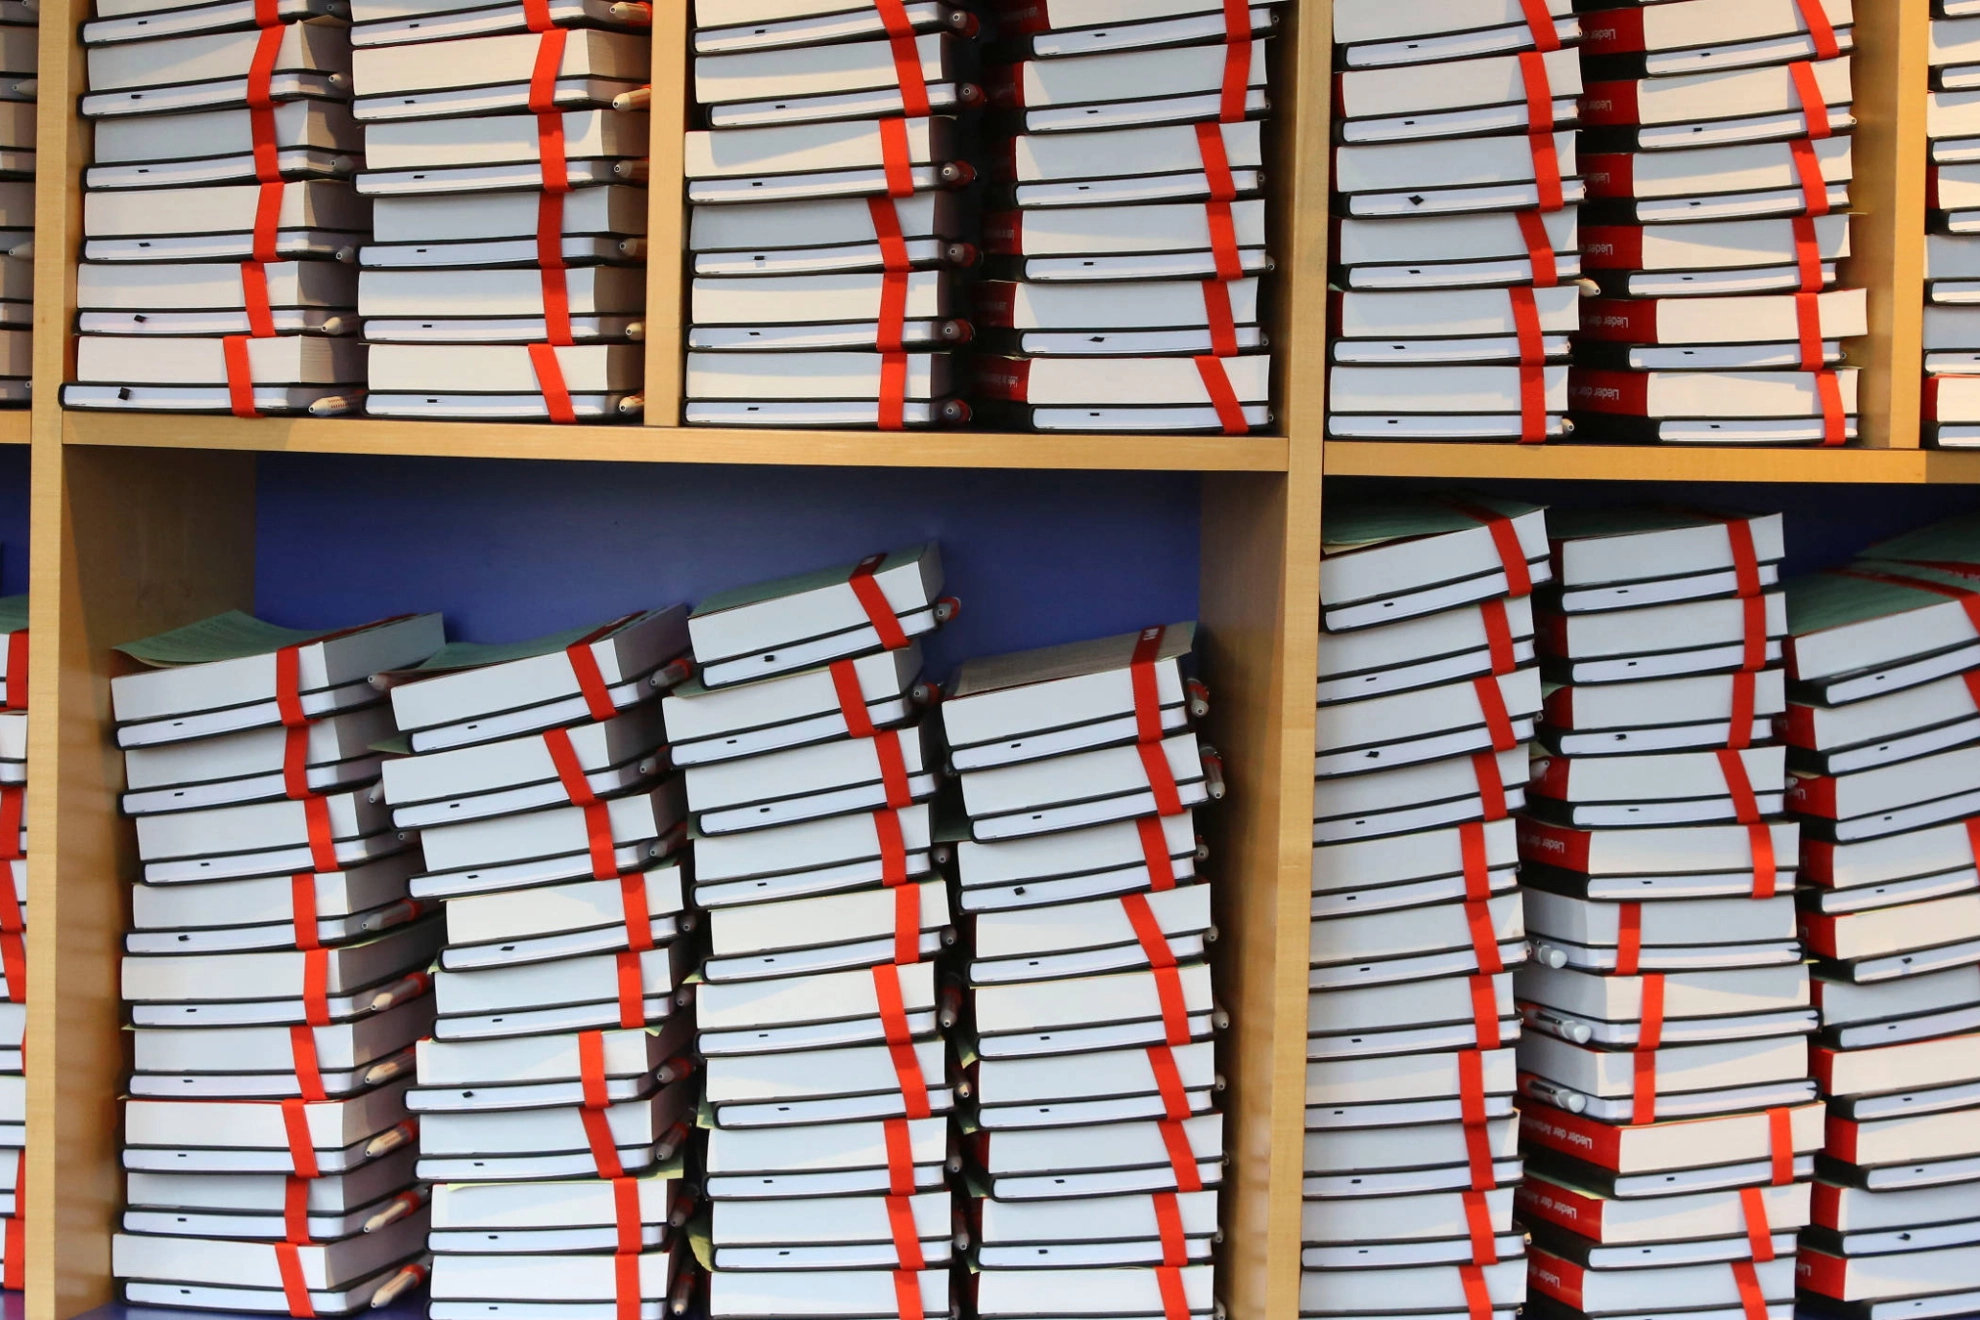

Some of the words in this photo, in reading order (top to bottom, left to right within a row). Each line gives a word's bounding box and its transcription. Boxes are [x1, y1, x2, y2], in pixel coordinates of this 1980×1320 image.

[1591, 28, 1616, 40] Lieder
[1589, 99, 1612, 111] Lieder
[1587, 243, 1613, 255] Lieder
[1602, 316, 1629, 329] Lieder
[1594, 388, 1620, 401] Lieder
[1541, 838, 1565, 854] Lieder
[1552, 1126, 1567, 1140] der
[1567, 1131, 1593, 1150] Lieder
[1553, 1201, 1577, 1220] Lieder
[1538, 1269, 1561, 1289] Lieder
